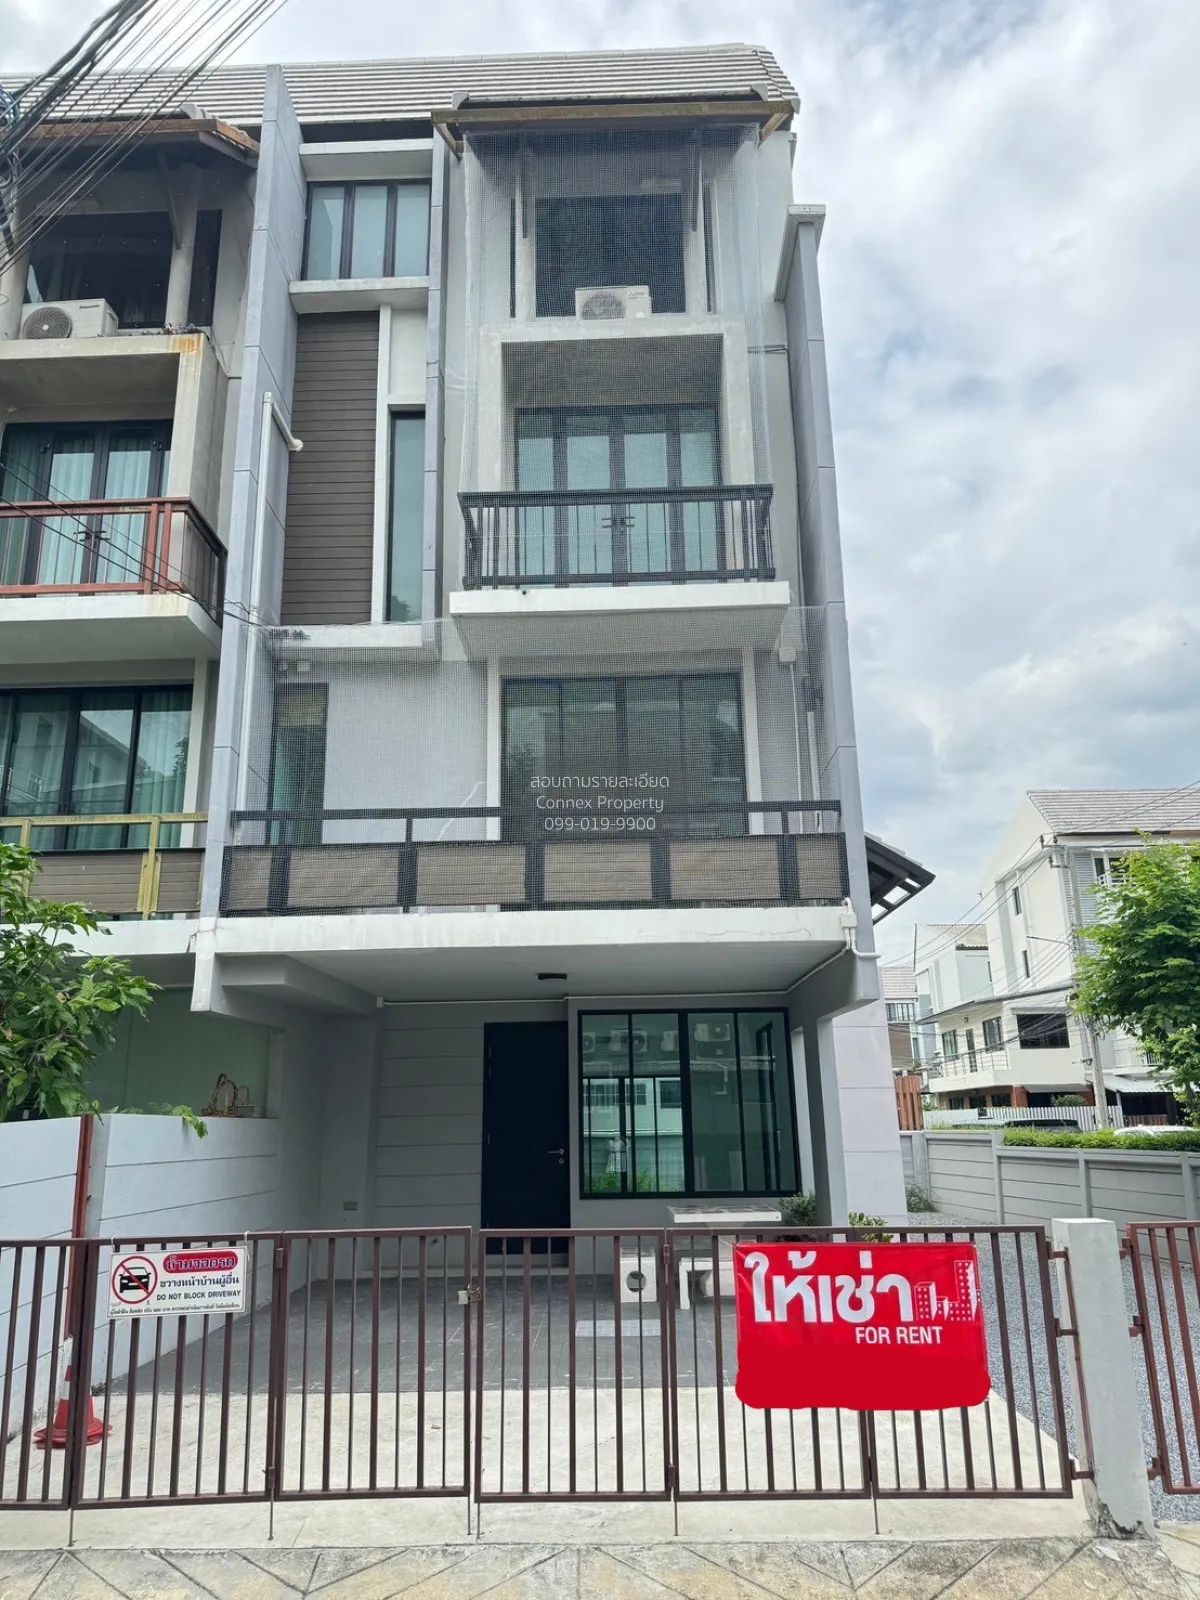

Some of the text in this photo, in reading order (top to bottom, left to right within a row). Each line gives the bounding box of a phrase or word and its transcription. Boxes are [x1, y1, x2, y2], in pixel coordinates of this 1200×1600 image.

[160, 1272, 239, 1288] ขวางหน้าบ้านผู้อื่น
[744, 1250, 914, 1323] ให้เช่า
[156, 1290, 241, 1301] DO NOT BLOCK DRIVEWAY
[855, 1326, 943, 1345] FOR RENT
